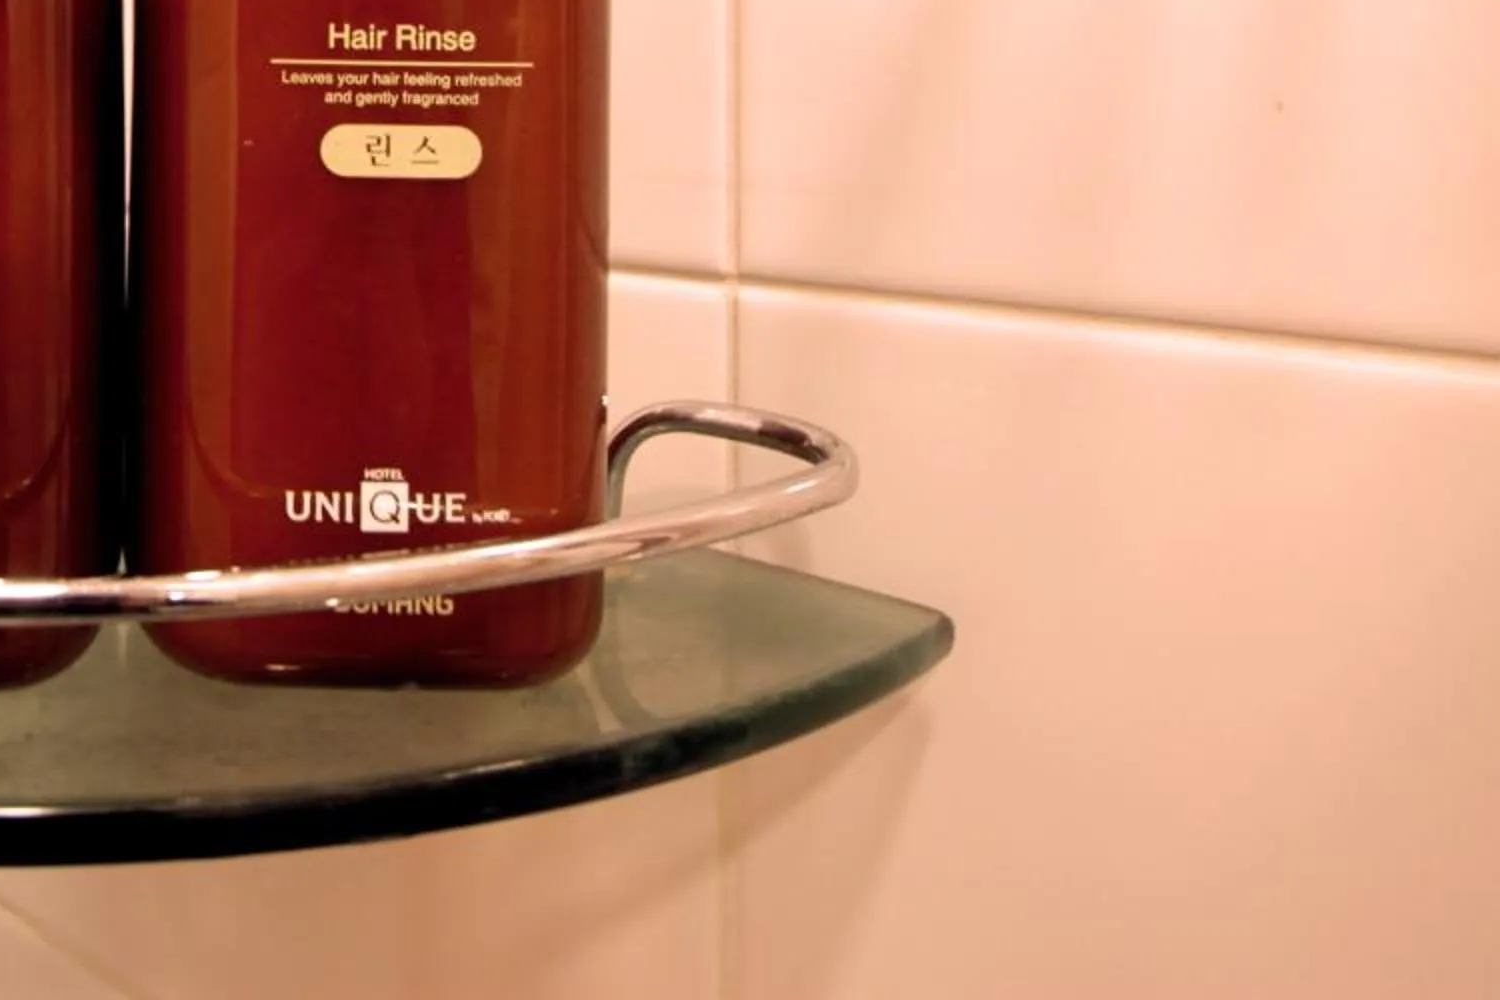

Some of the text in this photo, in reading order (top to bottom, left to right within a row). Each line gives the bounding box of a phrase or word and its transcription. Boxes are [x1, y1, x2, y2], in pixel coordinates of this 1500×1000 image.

[329, 23, 476, 51] Hair Rinse
[281, 70, 522, 89] Leaves your hair feeling refreshed
[324, 90, 479, 109] and gently fragranced
[364, 468, 405, 480] HOTEL
